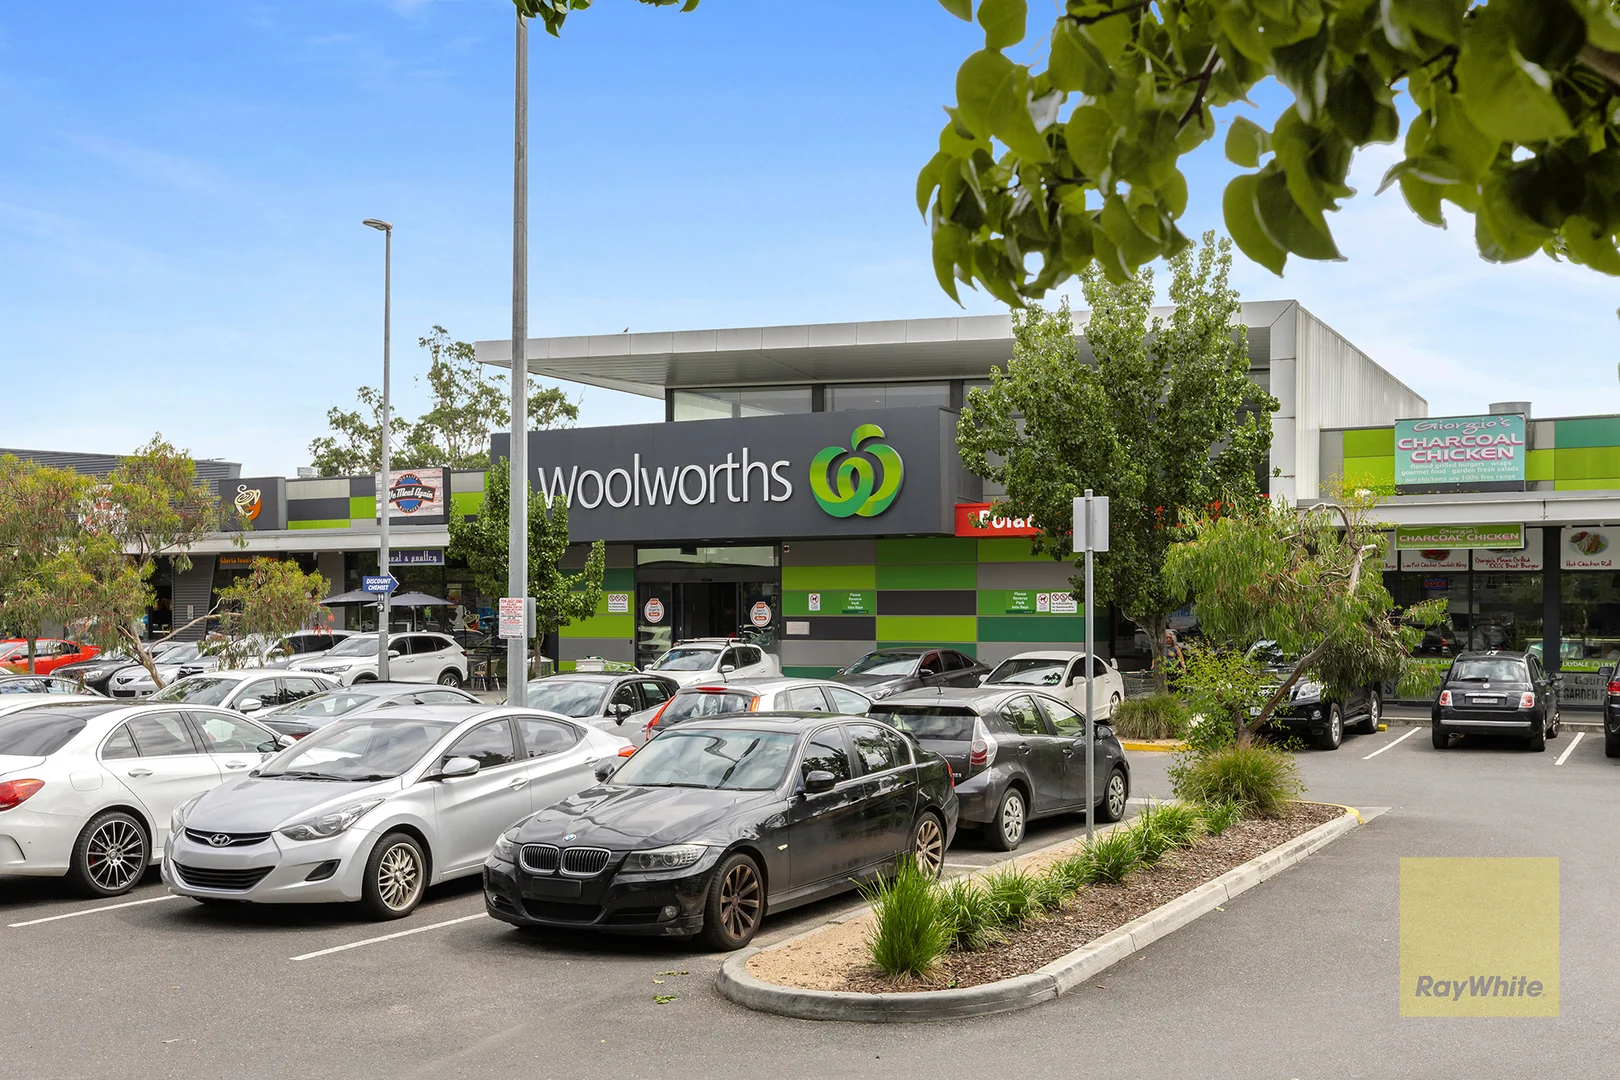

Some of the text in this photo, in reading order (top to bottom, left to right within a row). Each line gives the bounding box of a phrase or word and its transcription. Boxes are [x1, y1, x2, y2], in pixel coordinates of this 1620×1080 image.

[1412, 418, 1511, 436] Giorgio's
[1398, 433, 1524, 450] CHARCOAL
[1410, 446, 1514, 464] CHICKEN
[1458, 461, 1484, 469] burgers
[1564, 688, 1598, 700] GARDEN
